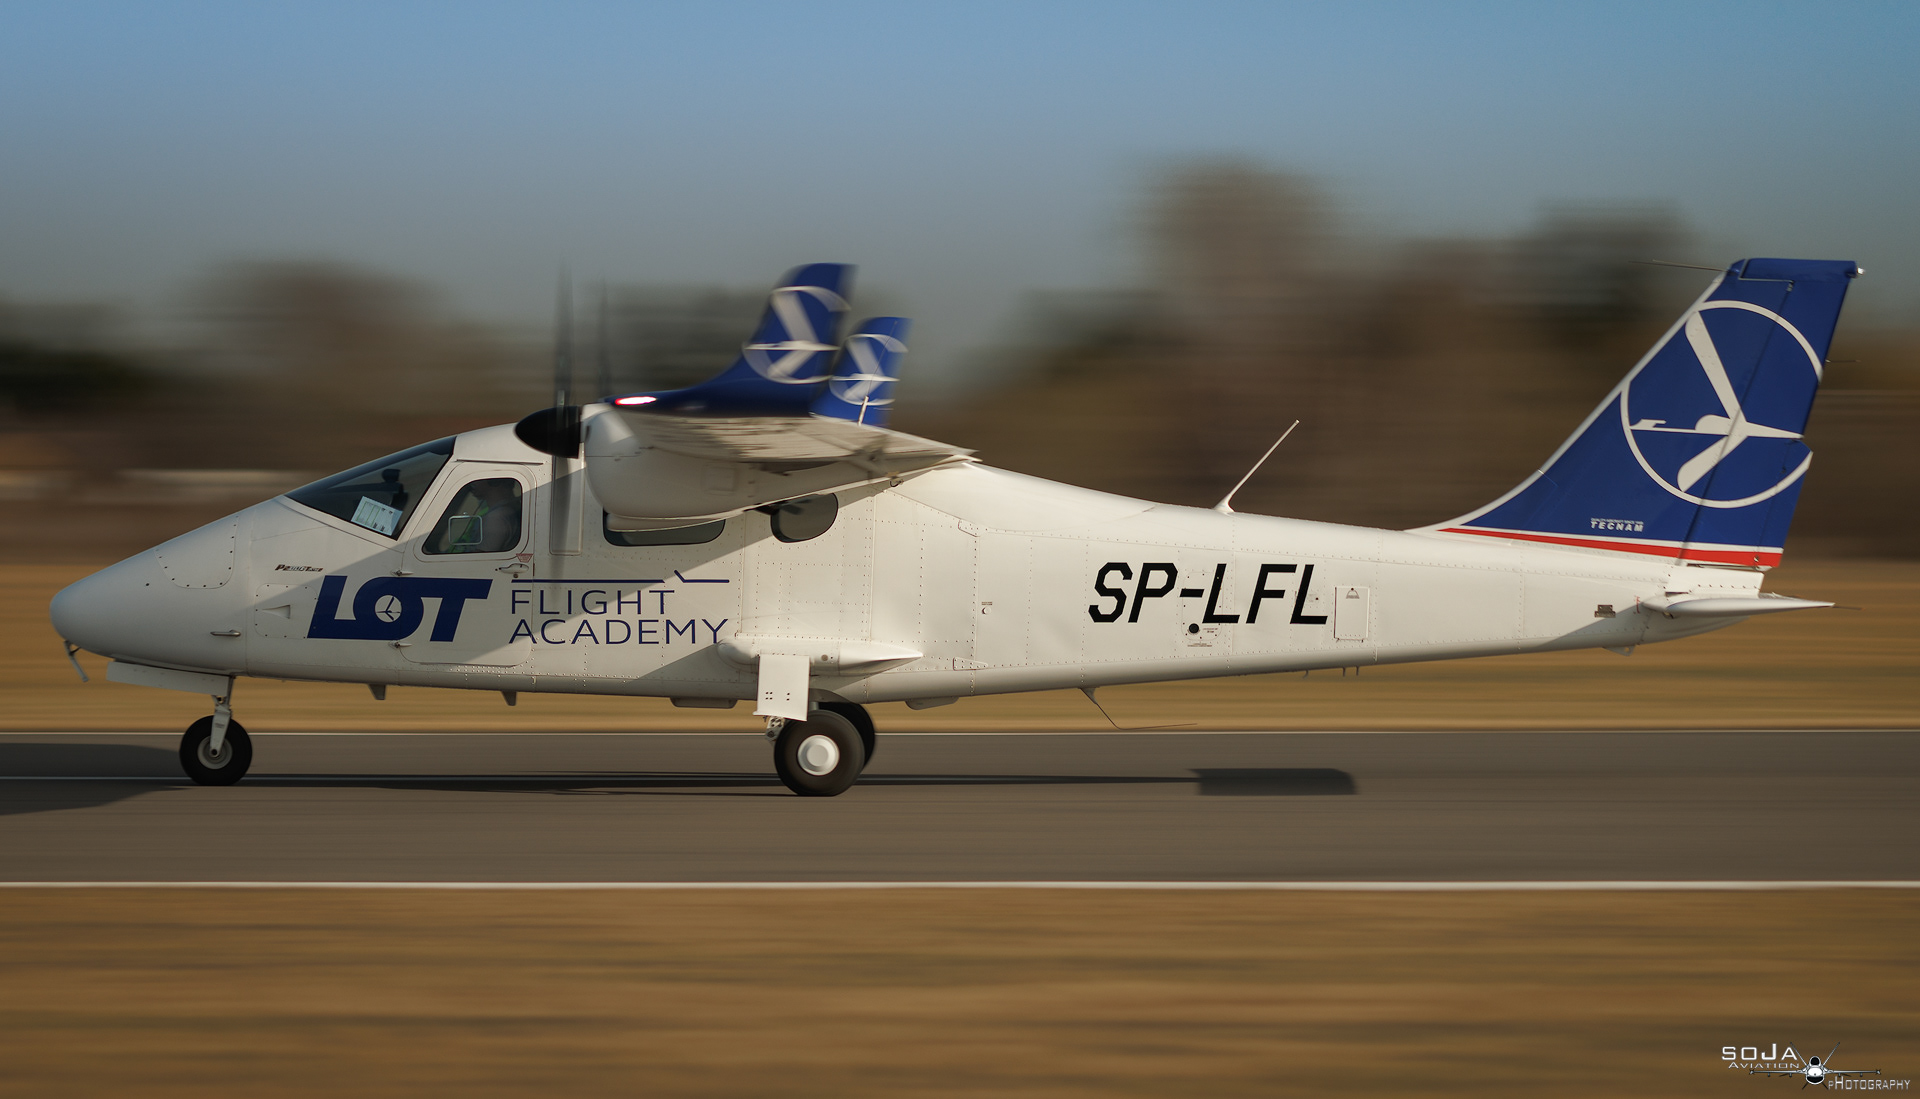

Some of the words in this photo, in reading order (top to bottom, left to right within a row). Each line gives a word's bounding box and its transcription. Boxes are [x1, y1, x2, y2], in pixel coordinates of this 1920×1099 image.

[1590, 521, 1644, 532] TECNAM
[511, 589, 675, 615] FLIGHT
[1088, 562, 1328, 625] SP-LFL
[307, 575, 493, 642] LOT
[508, 618, 729, 645] ACADEMY
